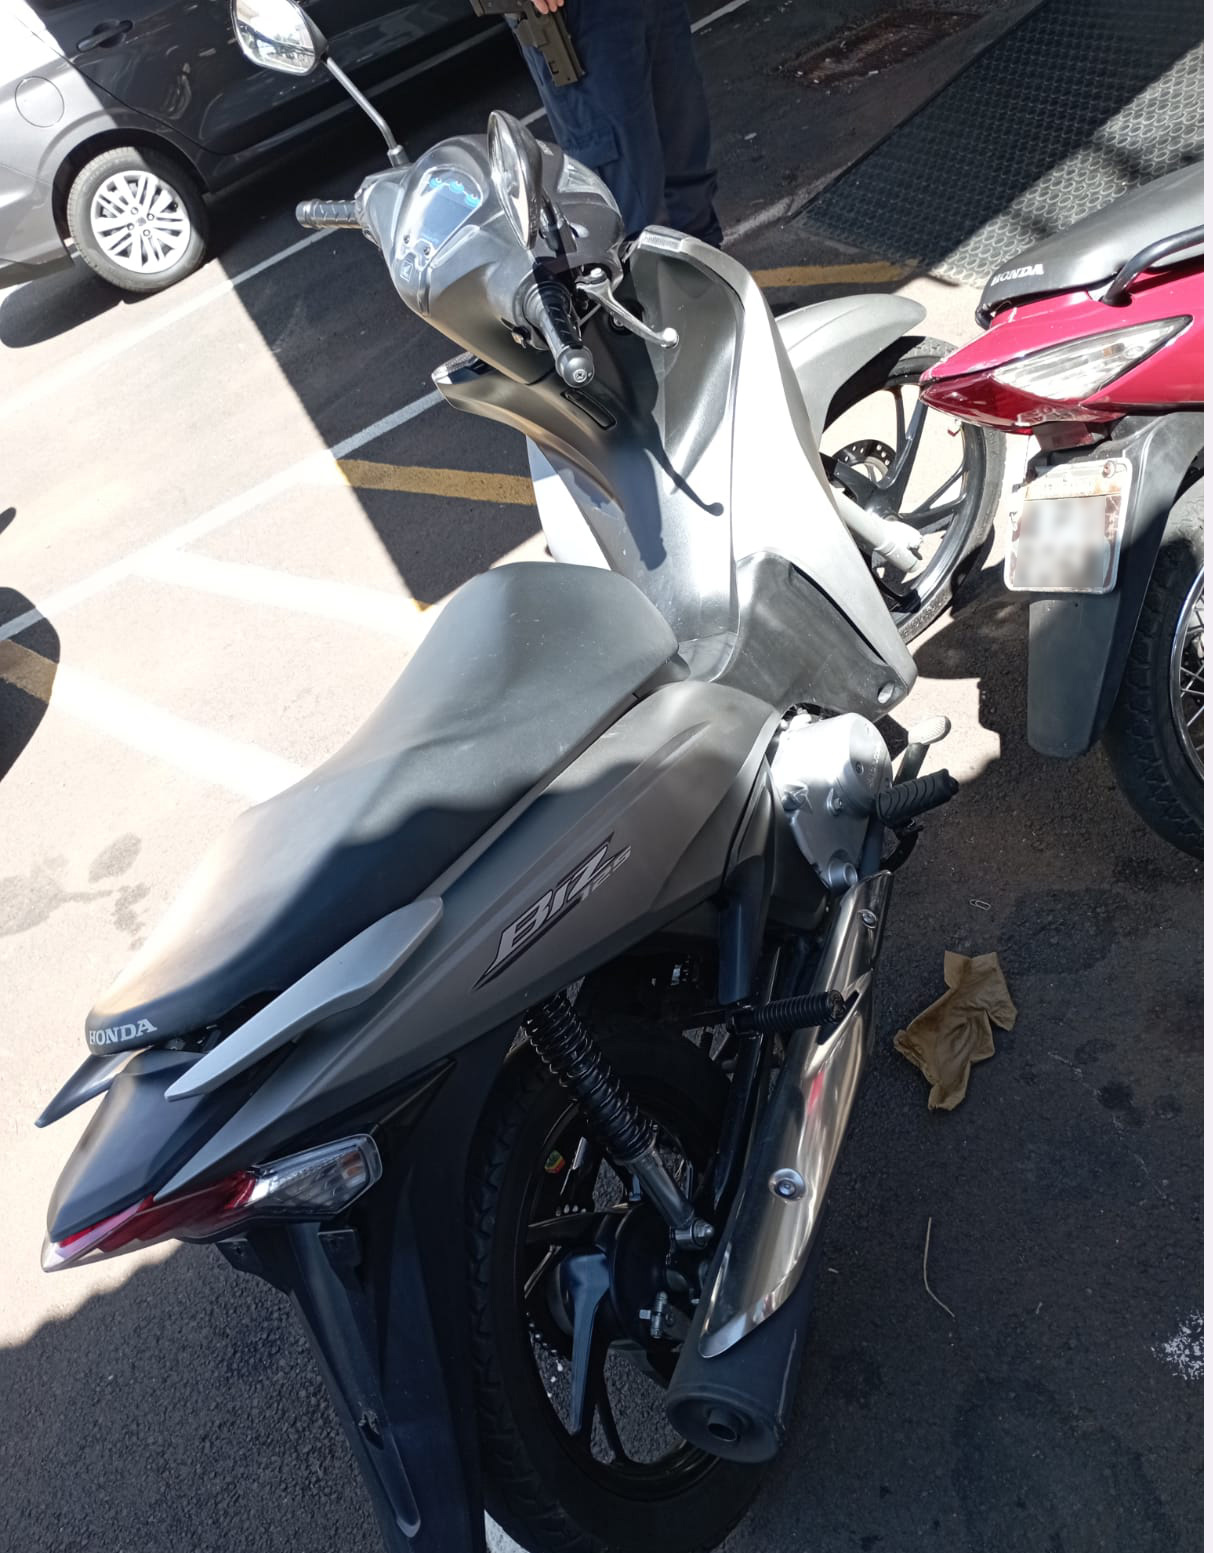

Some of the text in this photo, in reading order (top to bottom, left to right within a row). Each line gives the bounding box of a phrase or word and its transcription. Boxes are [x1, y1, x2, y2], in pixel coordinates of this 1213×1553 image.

[990, 263, 1045, 287] HONDA
[480, 842, 610, 980] BIZ
[89, 1018, 158, 1046] HONDA
